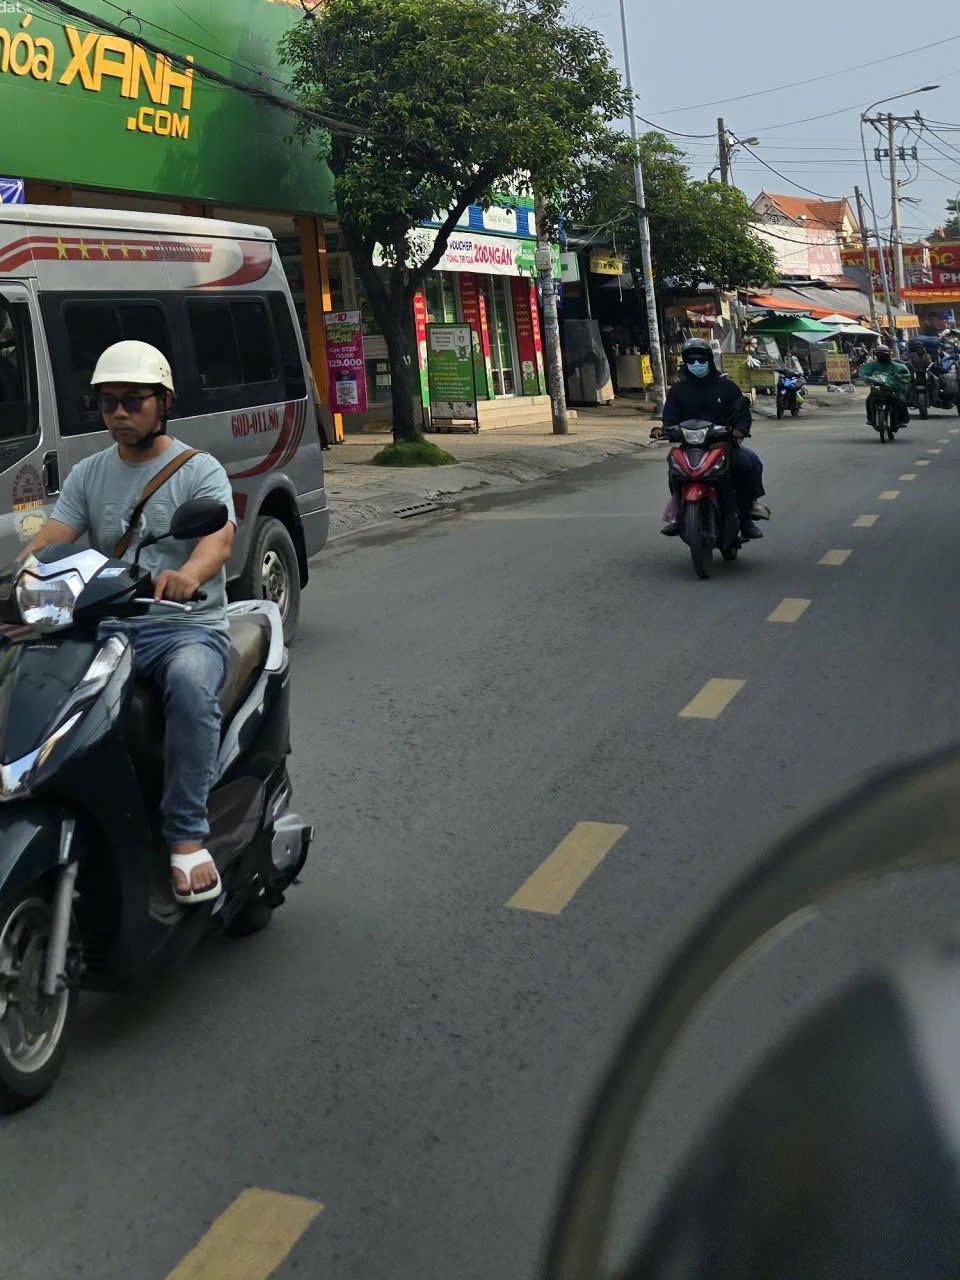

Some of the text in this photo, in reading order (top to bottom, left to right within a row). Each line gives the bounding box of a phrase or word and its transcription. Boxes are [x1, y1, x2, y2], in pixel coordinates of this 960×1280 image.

[57, 24, 194, 110] XANH
[125, 106, 191, 140] .COM
[448, 240, 473, 251] VOUCHER
[329, 359, 362, 368] 129.000
